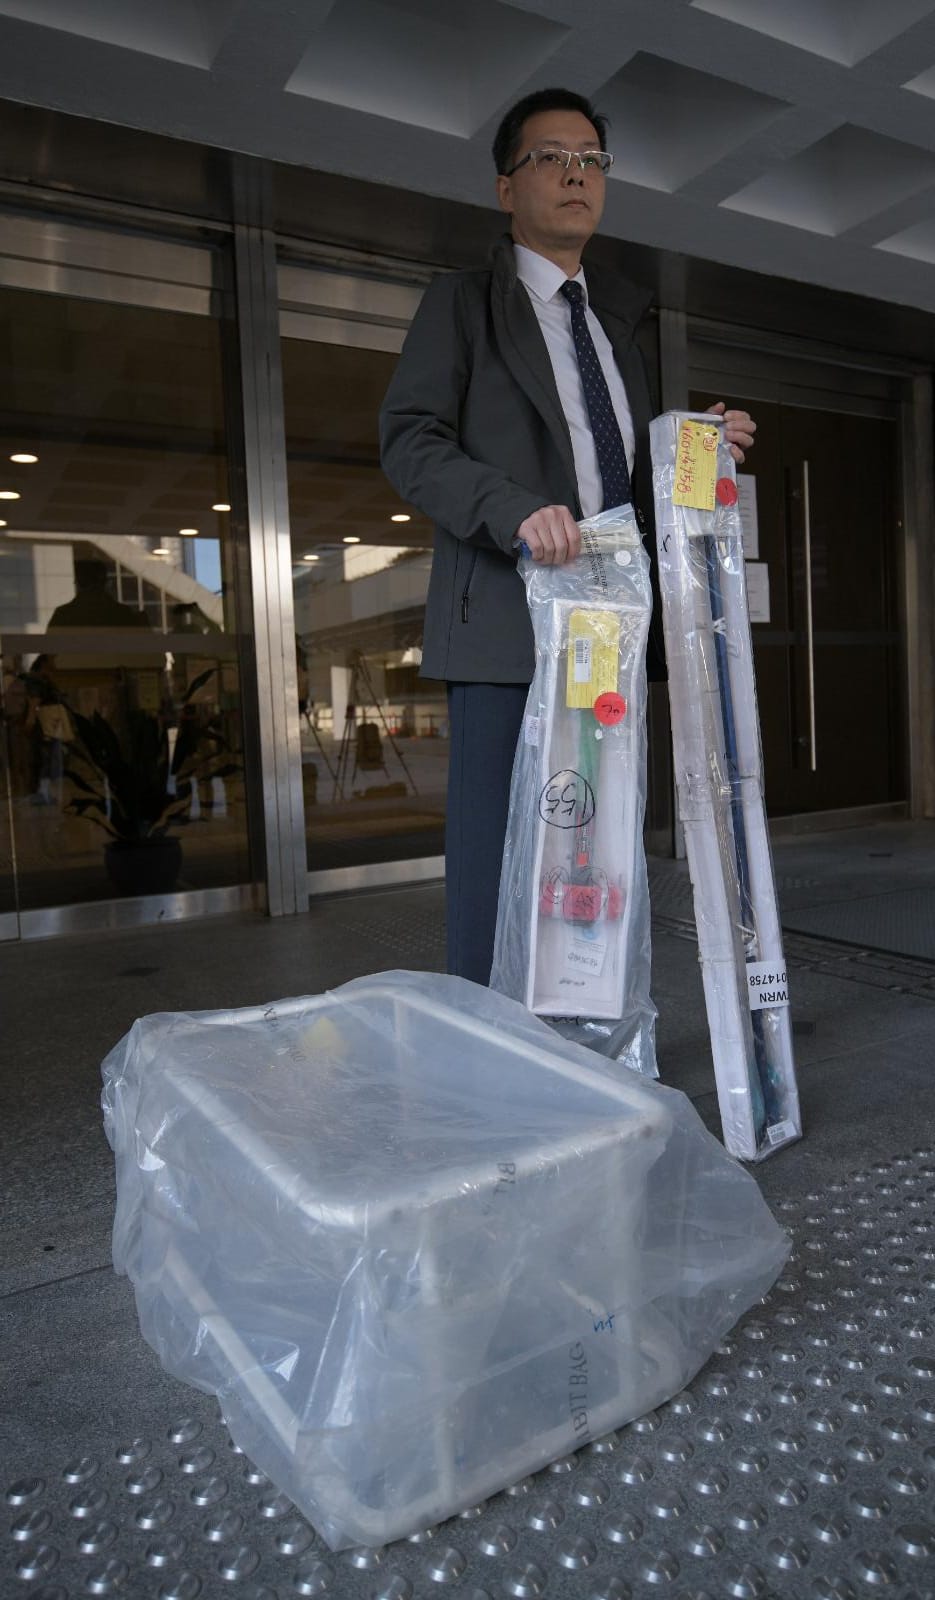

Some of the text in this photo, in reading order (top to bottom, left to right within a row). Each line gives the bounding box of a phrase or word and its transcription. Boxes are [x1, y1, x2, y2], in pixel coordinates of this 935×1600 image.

[545, 783, 588, 819] 155
[749, 972, 787, 986] 014758
[759, 991, 789, 1003] WRN
[569, 1341, 589, 1385] BAG
